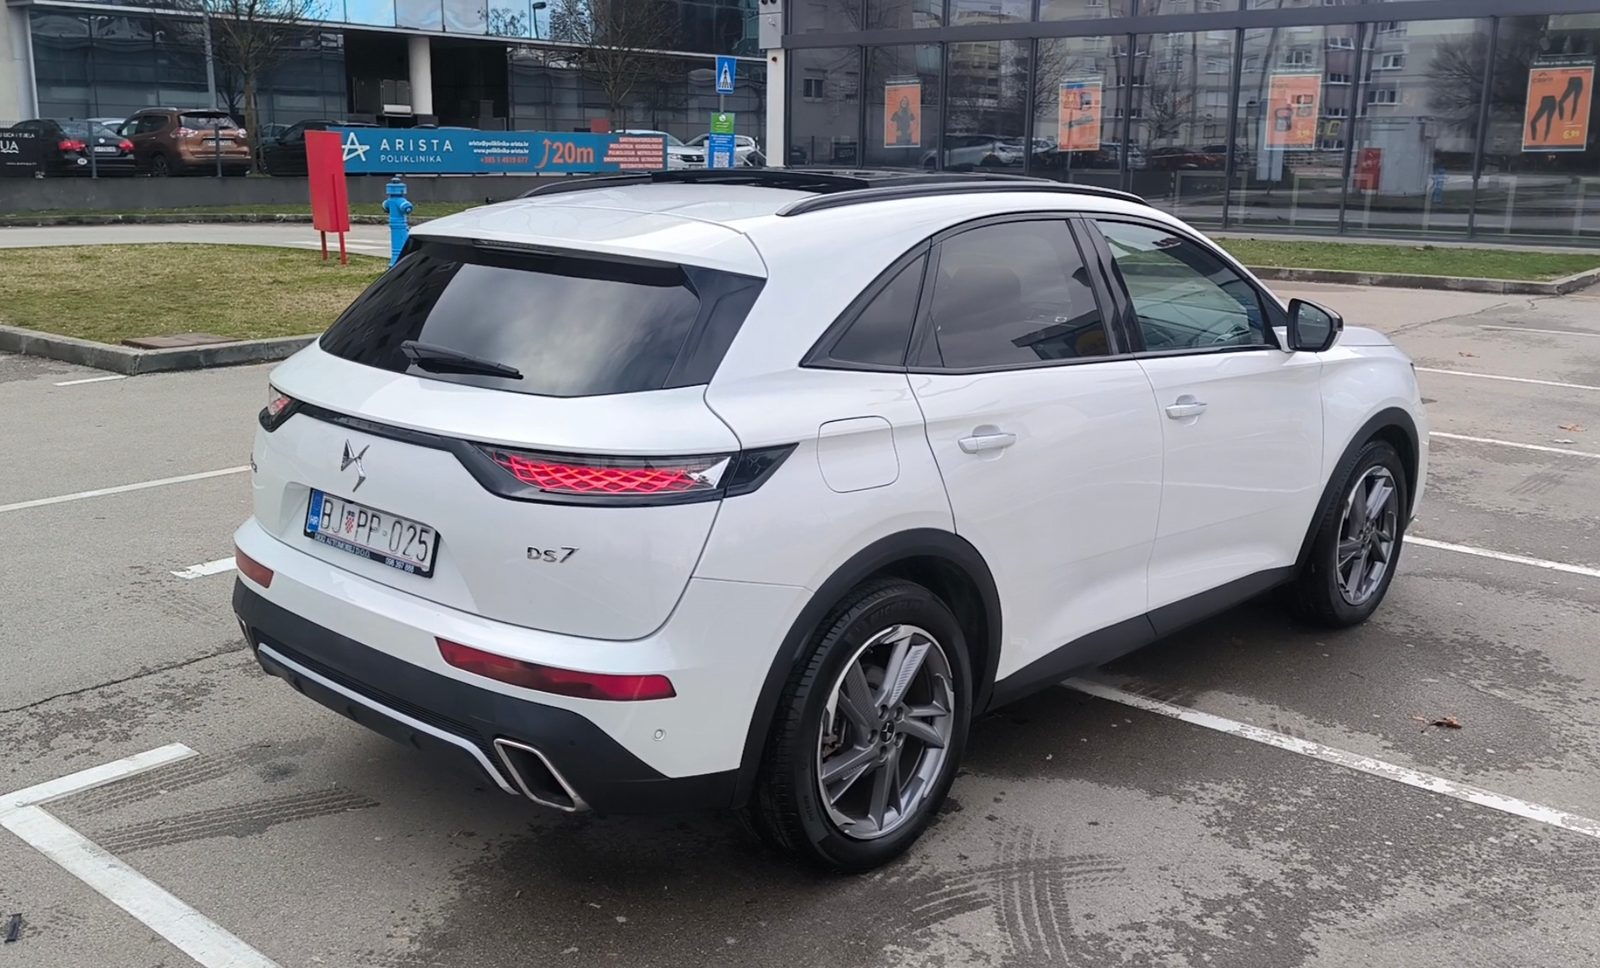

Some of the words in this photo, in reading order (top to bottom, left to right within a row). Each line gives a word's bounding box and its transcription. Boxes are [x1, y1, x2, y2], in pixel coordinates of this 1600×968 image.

[380, 138, 453, 152] ARISTA
[552, 142, 594, 164] 20m
[380, 155, 442, 163] POLIKLINIKA
[321, 499, 345, 533] BJ
